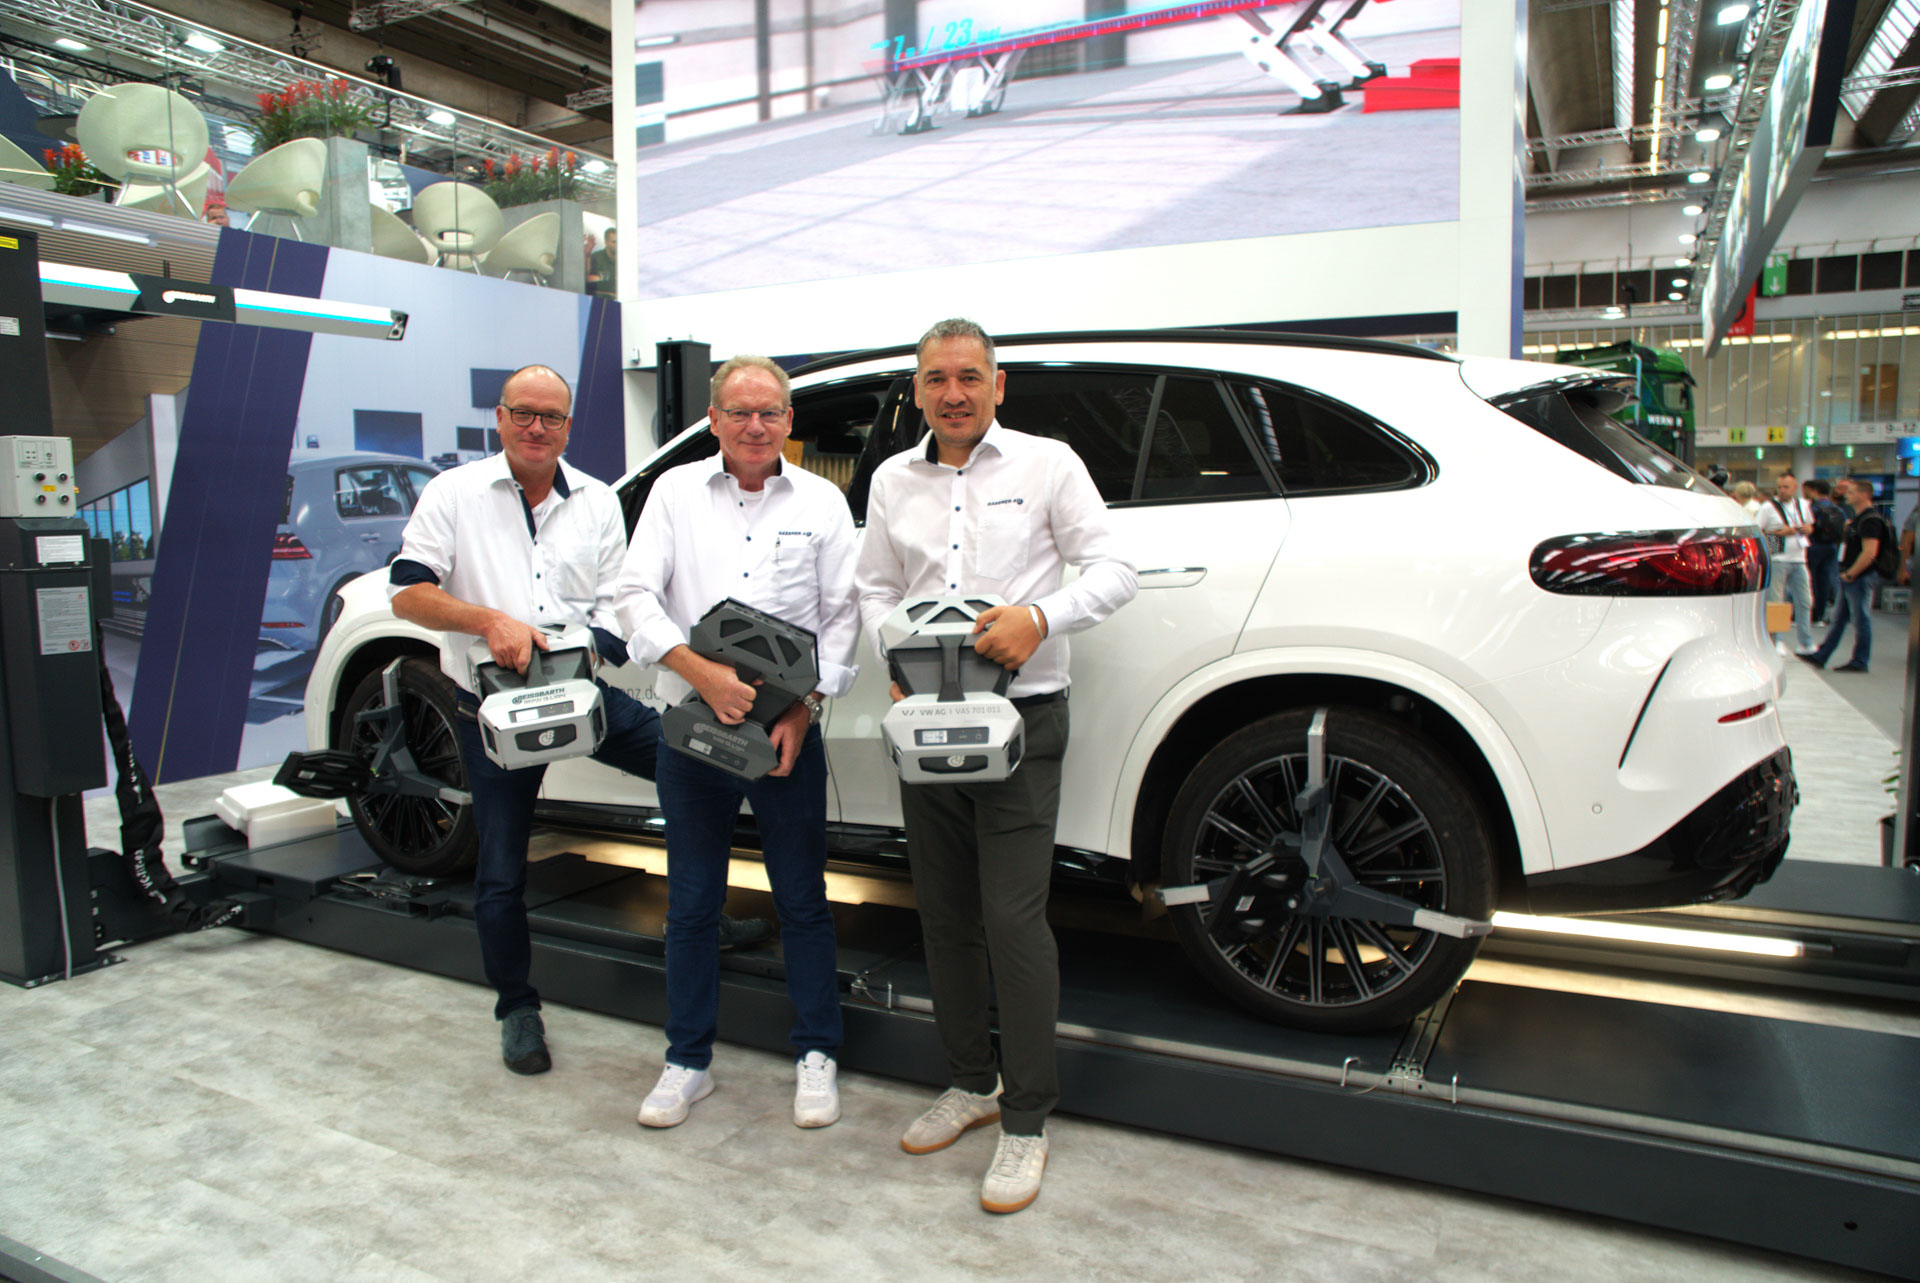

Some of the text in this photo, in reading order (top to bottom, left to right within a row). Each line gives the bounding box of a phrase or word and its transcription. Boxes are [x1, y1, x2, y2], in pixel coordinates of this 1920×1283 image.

[943, 18, 973, 49] 23
[512, 688, 565, 704] BEISSBARTH
[920, 708, 934, 716] VW
[935, 708, 946, 716] AG
[972, 706, 985, 714] 701
[987, 705, 1001, 713] 011
